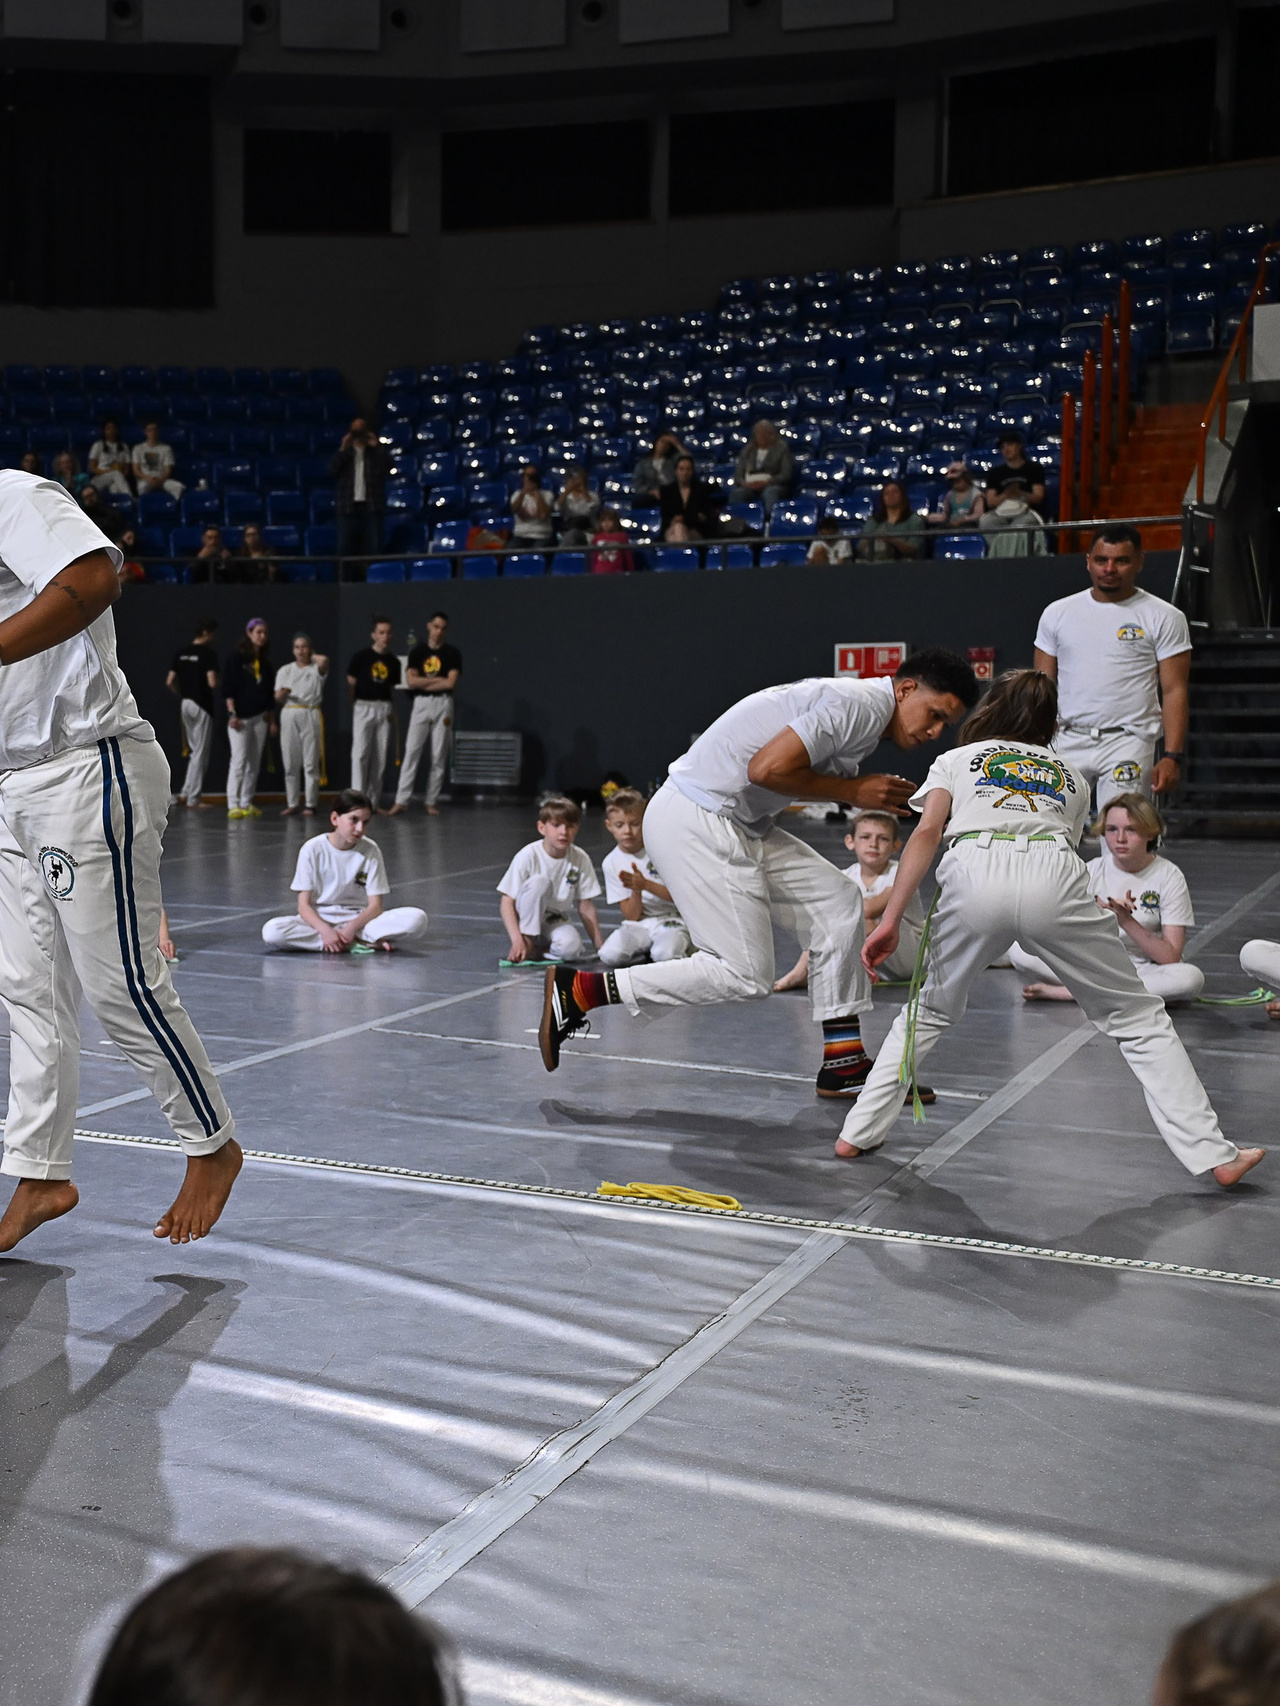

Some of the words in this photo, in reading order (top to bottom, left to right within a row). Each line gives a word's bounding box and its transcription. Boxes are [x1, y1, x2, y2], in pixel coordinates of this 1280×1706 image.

[1026, 751, 1049, 760] DE
[1053, 759, 1076, 794] OURO
[975, 776, 1066, 807] CAPOEIRA
